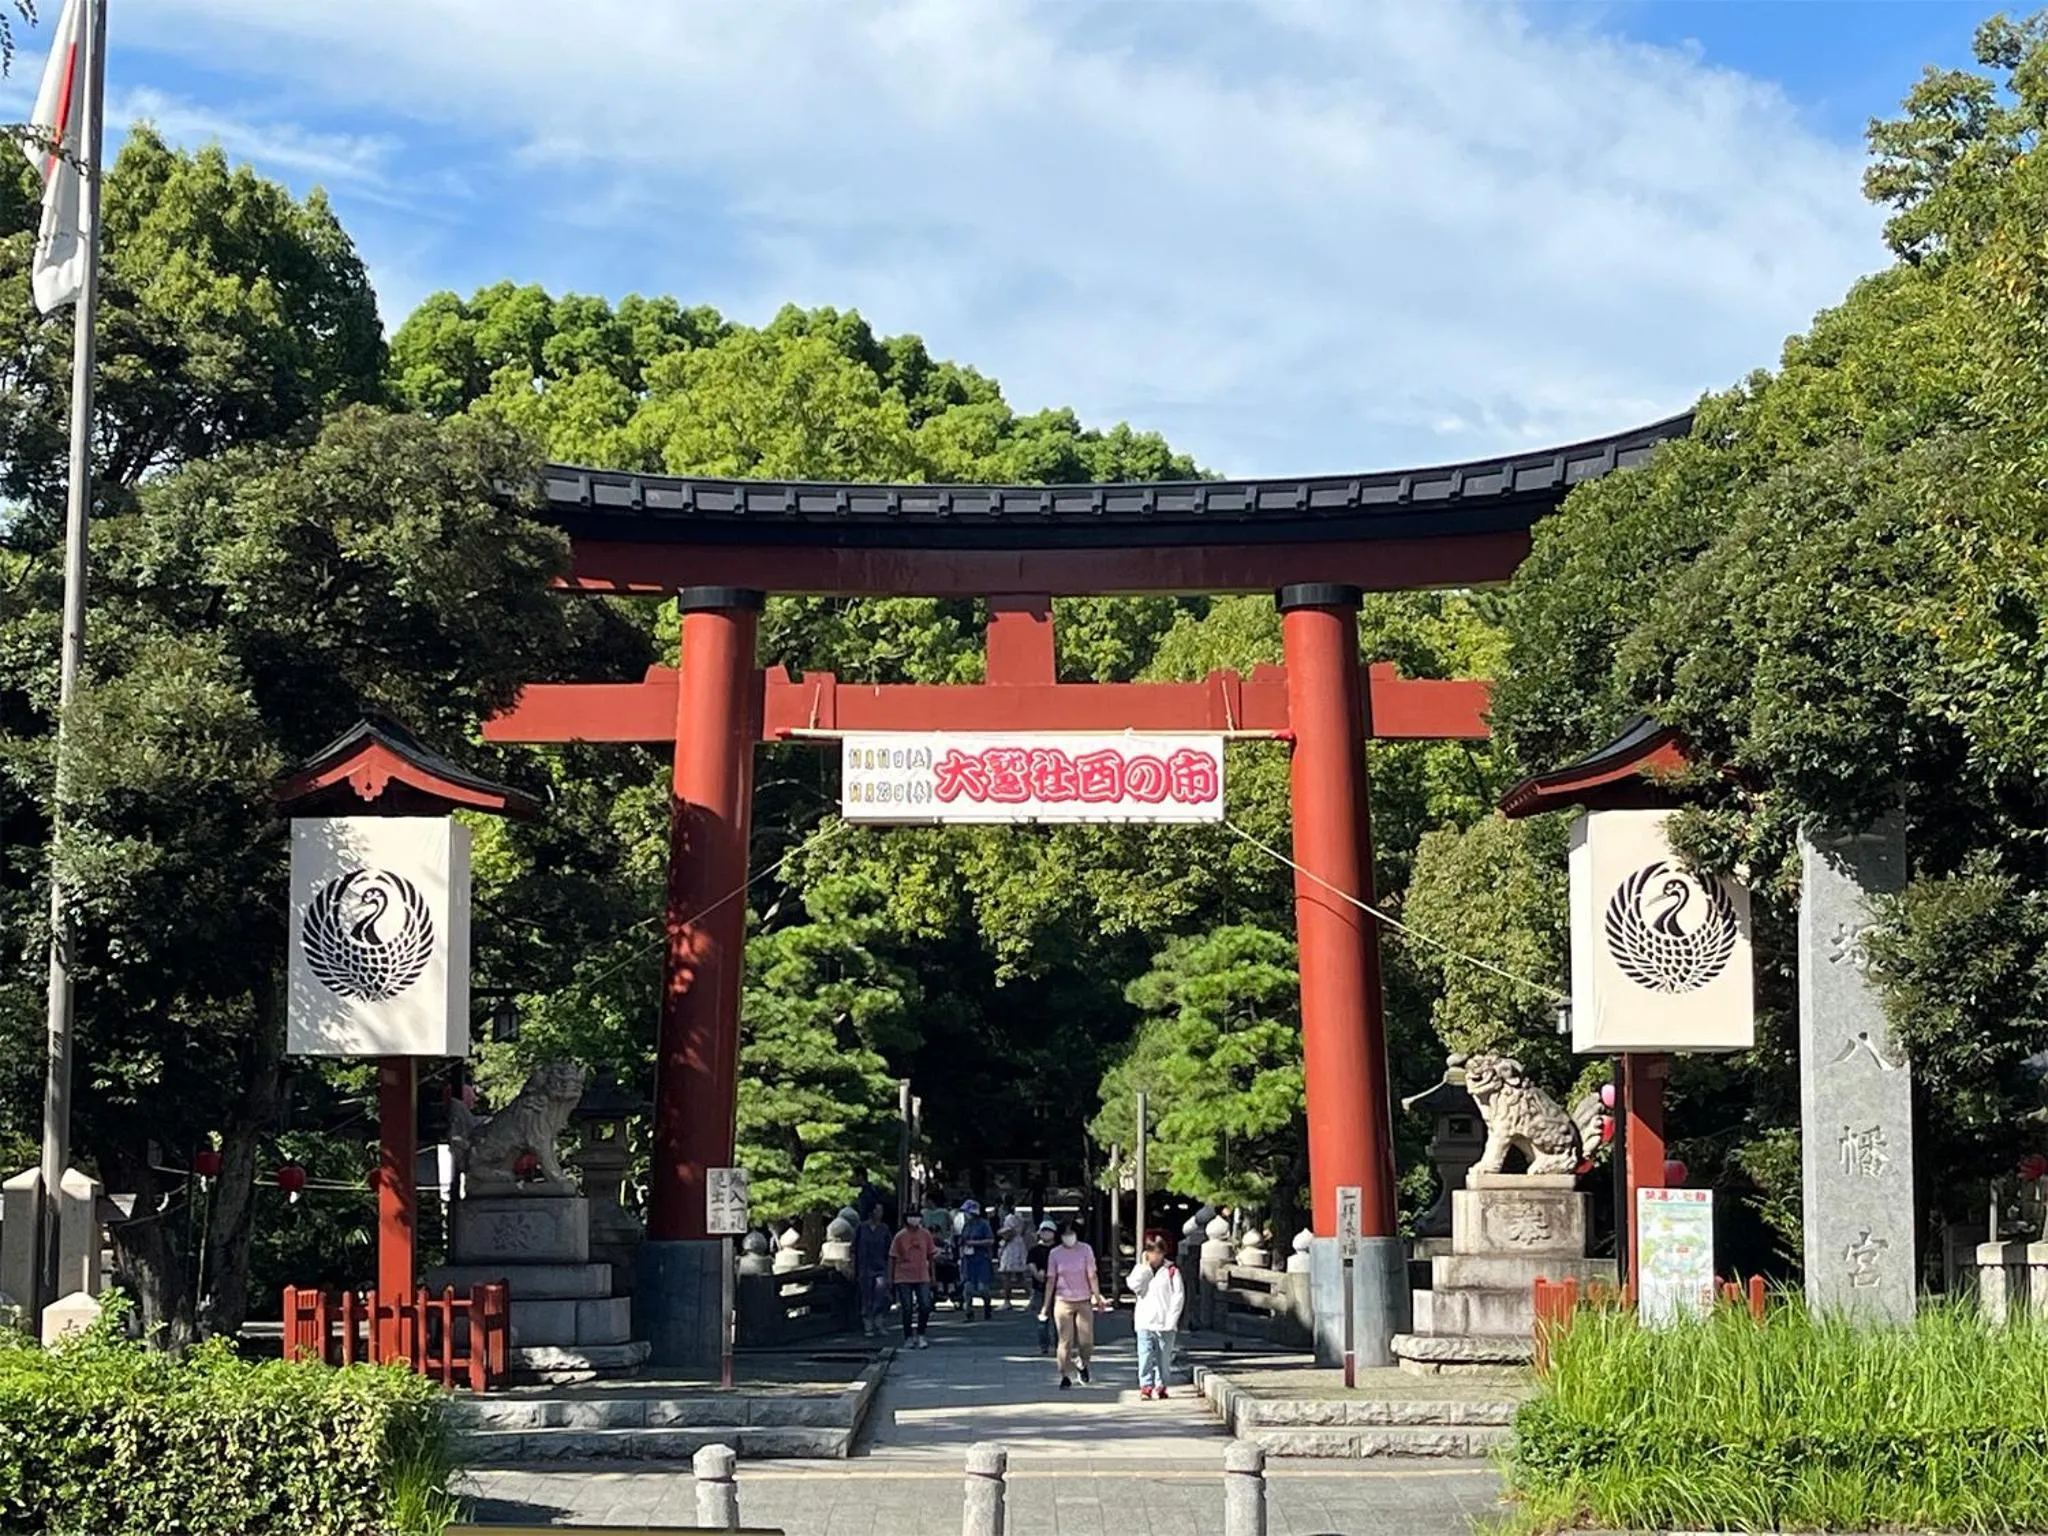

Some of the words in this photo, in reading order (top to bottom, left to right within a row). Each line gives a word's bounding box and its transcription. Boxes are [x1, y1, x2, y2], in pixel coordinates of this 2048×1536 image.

[935, 746, 1218, 804] 大鷲社酉の市
